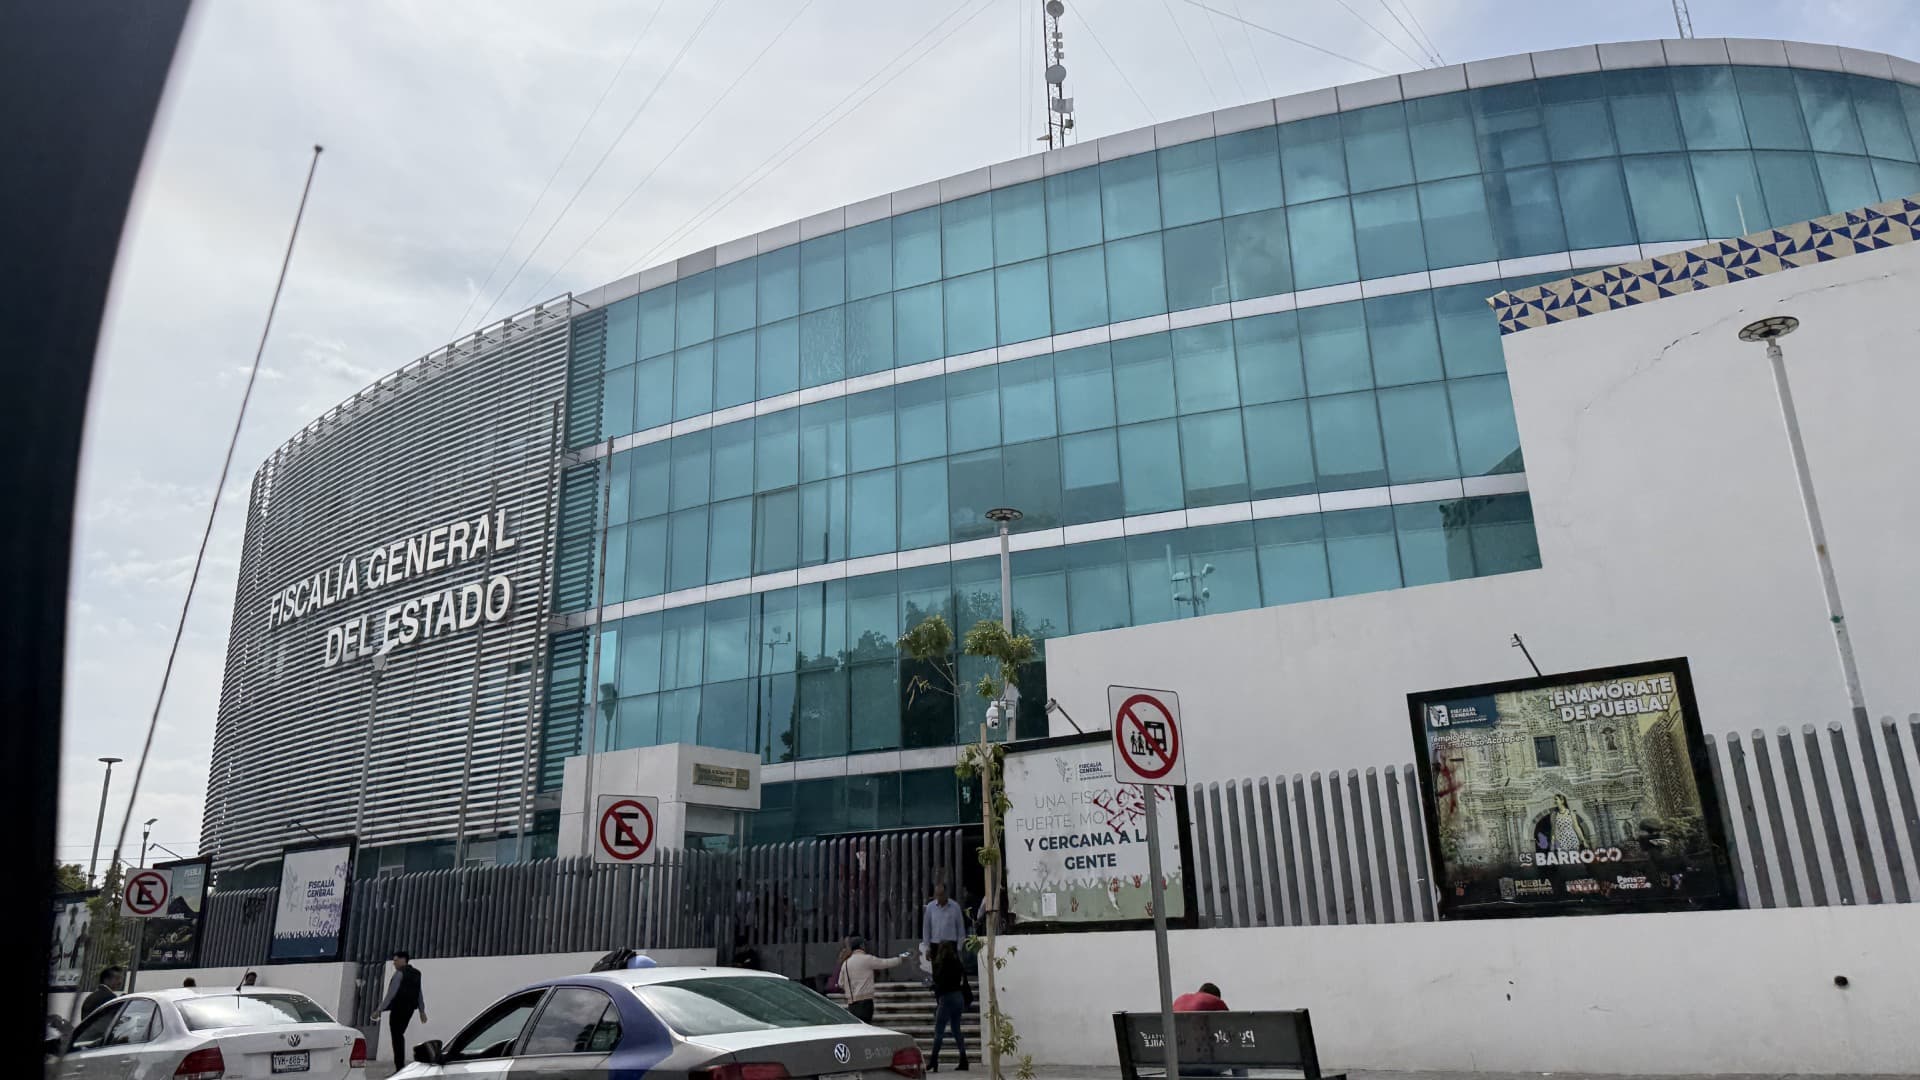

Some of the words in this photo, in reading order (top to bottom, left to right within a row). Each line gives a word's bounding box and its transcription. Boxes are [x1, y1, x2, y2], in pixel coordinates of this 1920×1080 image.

[268, 554, 358, 630] FISCALÍA
[367, 508, 516, 590] GENERAL
[324, 613, 374, 668] DEL
[383, 575, 512, 648] ESTADO
[1548, 677, 1673, 710] ¡ENAMÓRATE
[1560, 705, 1587, 722] DE
[1589, 695, 1670, 719] PUEBLA!
[1034, 794, 1066, 809] UNA
[1024, 838, 1036, 852] Y
[1038, 832, 1115, 851] CERCANA
[1119, 831, 1131, 844] A
[1135, 829, 1149, 843] L
[1064, 853, 1118, 870] GENTE
[1535, 847, 1623, 867] BARROCO
